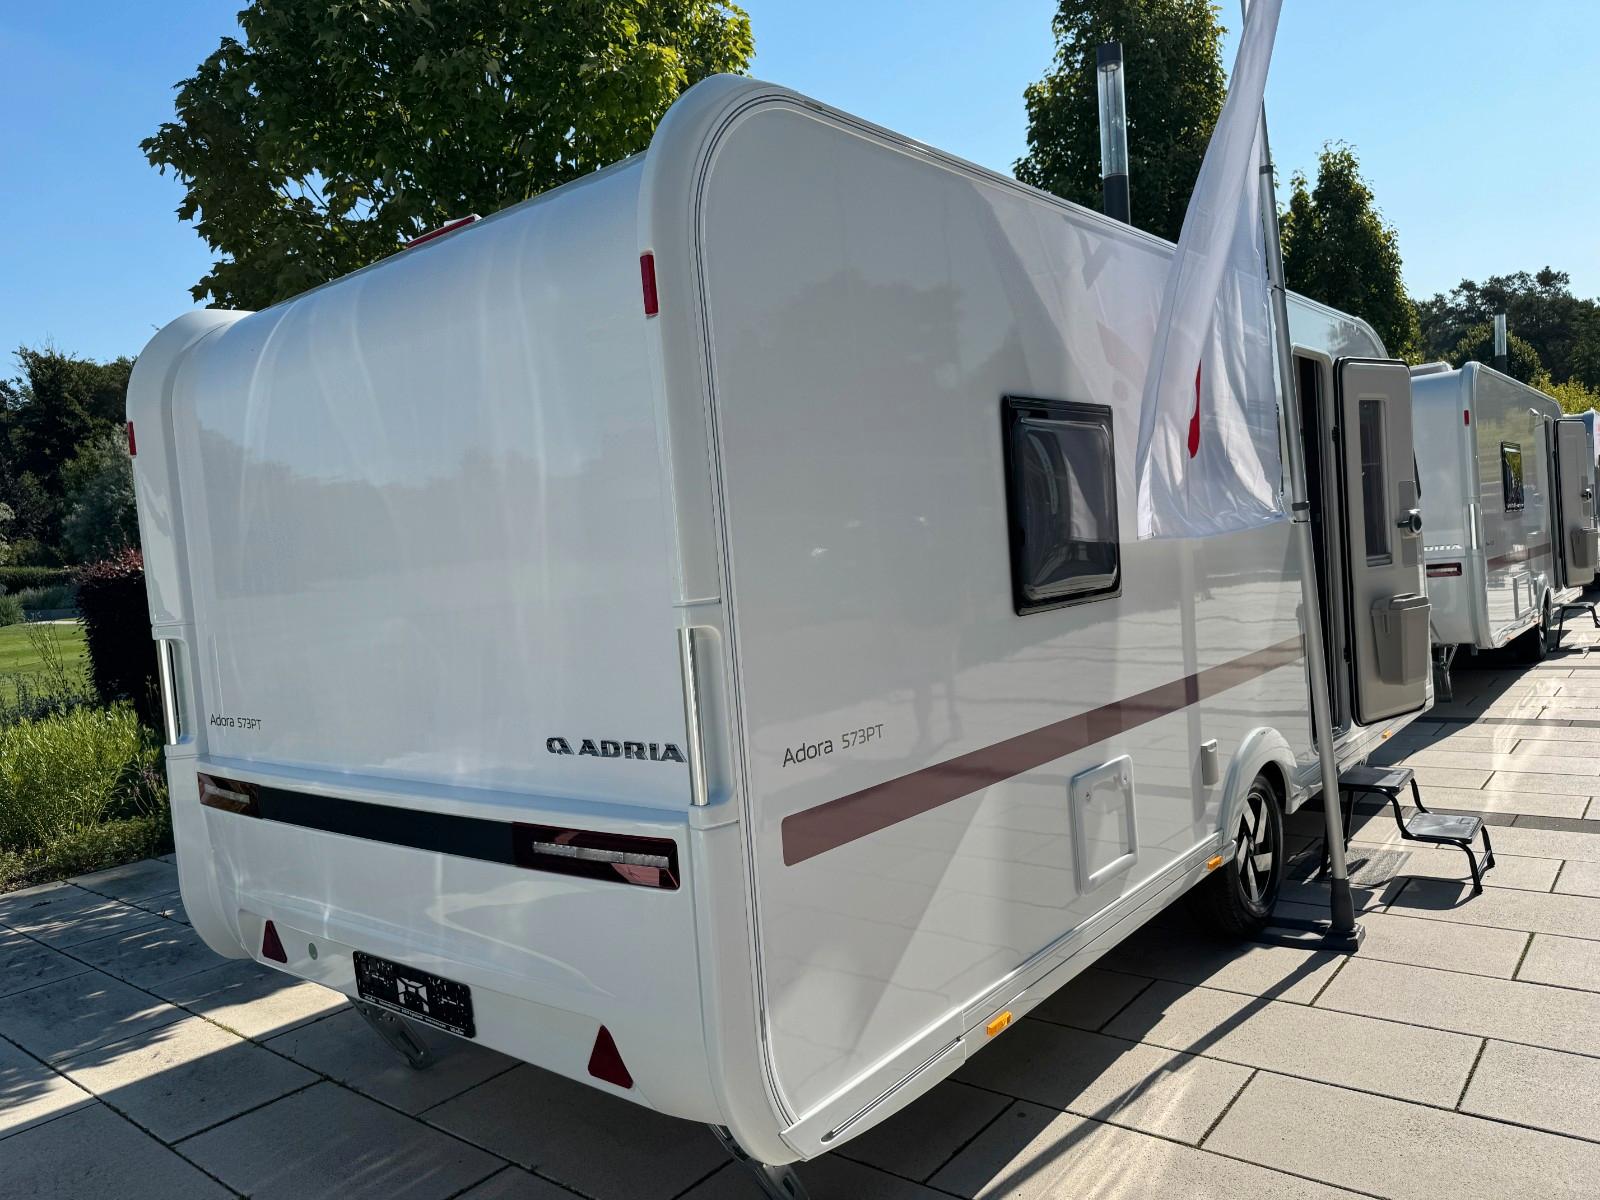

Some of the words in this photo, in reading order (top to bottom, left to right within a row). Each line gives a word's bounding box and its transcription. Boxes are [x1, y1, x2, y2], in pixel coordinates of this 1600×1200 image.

[1424, 543, 1462, 552] DRIA
[210, 713, 235, 728] Adora
[237, 717, 262, 731] 573PT
[578, 738, 687, 763] ADRIA
[782, 739, 834, 768] Adora
[841, 723, 884, 750] 573PT
